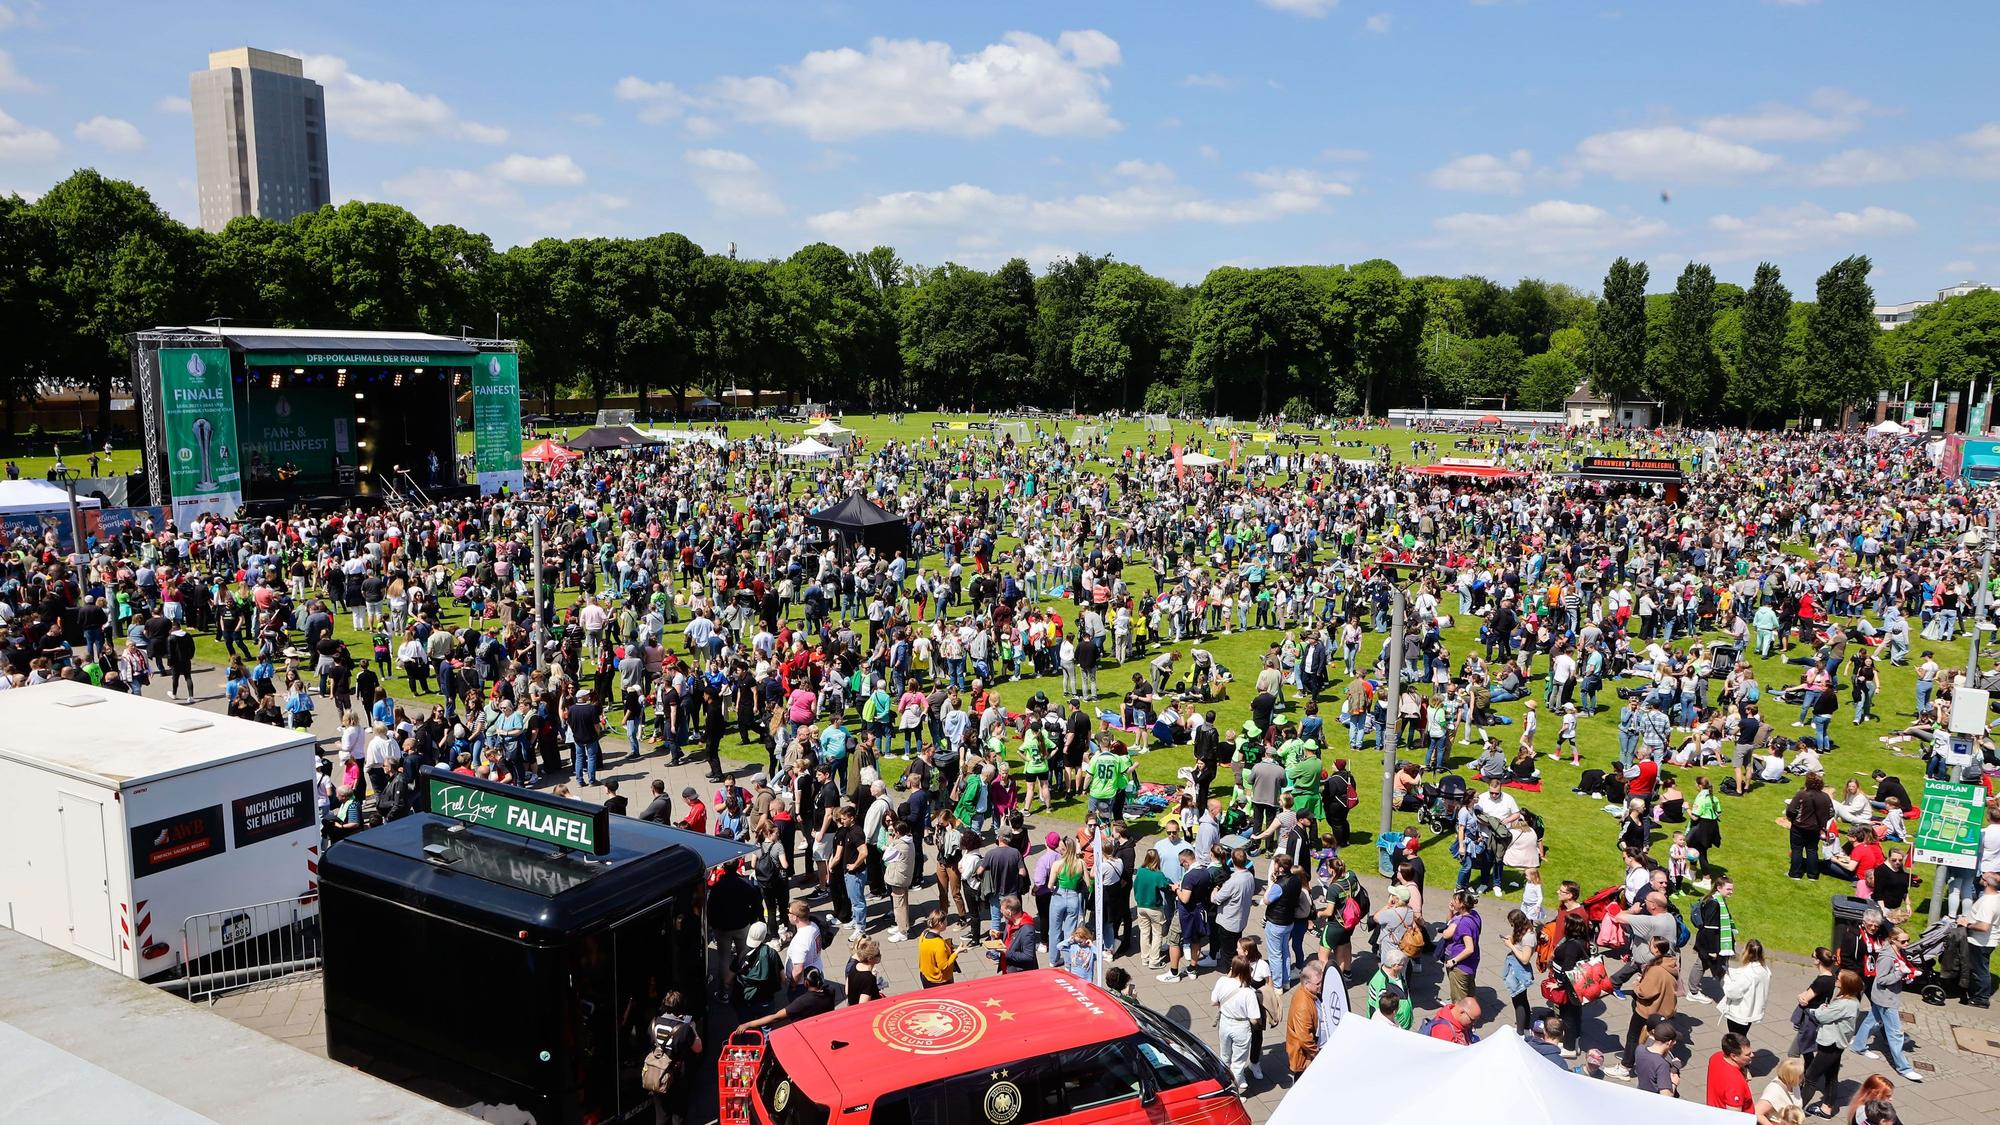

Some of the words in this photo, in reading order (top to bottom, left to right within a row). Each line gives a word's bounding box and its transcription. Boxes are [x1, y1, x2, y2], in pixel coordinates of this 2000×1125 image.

[383, 355, 399, 363] DER
[400, 355, 430, 364] FRAUEN
[174, 388, 224, 401] FINALE
[475, 385, 516, 395] FANFEST
[263, 427, 295, 439] FAN-
[297, 426, 306, 438] &
[241, 438, 329, 454] FAMILIENFEST
[1925, 782, 1968, 794] LAGEPLAN
[245, 799, 268, 817] MICH
[269, 791, 302, 810] KÖNNEN
[246, 815, 260, 831] SIE
[261, 806, 295, 827] MIETEN!
[437, 785, 465, 816] Feel
[467, 789, 498, 823] Good
[506, 805, 592, 845] FALAFEL
[1054, 978, 1104, 1015] #INTEAM
